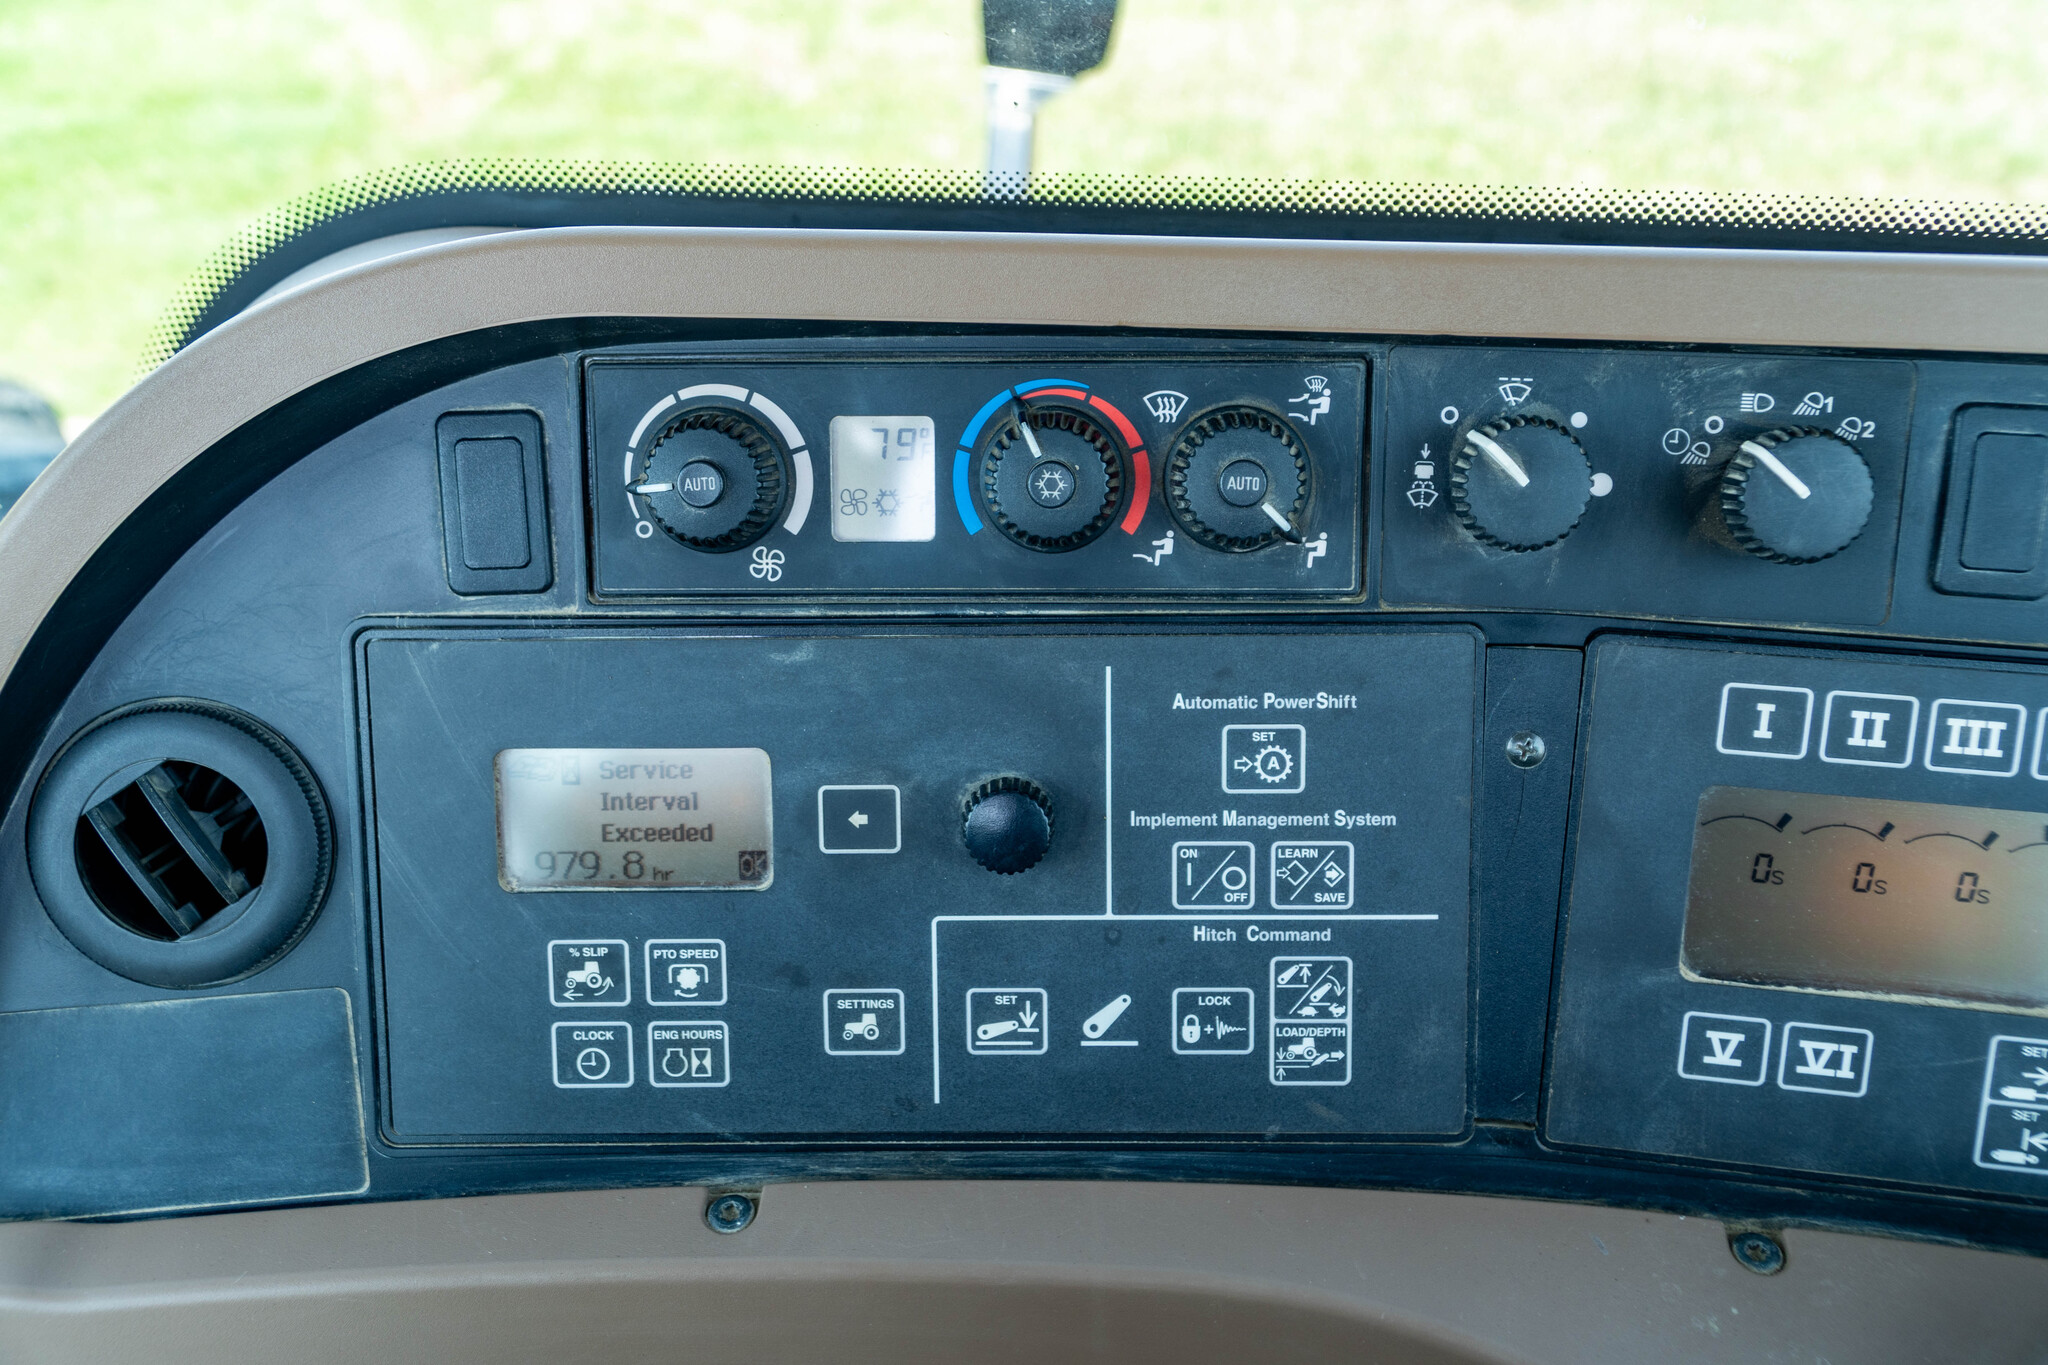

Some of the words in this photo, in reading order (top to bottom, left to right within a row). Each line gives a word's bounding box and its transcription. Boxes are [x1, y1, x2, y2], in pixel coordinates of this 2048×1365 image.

[1824, 396, 1834, 413] 1
[1861, 421, 1876, 439] 2
[683, 476, 716, 492] AUTO
[1226, 476, 1260, 491] AUTO
[1172, 693, 1258, 710] Automatic
[1263, 692, 1358, 710] PowerShift
[1753, 702, 1776, 739] I
[1252, 732, 1276, 742] SET
[1847, 710, 1891, 748] II
[1943, 718, 2007, 758] III
[599, 760, 693, 780] Service
[600, 792, 699, 811] Interval
[1130, 810, 1218, 830] Implement
[1222, 809, 1330, 830] Management
[1334, 809, 1397, 829] System
[601, 823, 714, 843] Exceeded
[1180, 849, 1198, 859] ON
[1278, 849, 1319, 859] LEARN
[534, 851, 645, 880] 979.8
[653, 867, 675, 881] hr
[739, 851, 767, 880] OK
[1224, 893, 1248, 903] OFF
[1314, 893, 1346, 903] SAVE
[1193, 925, 1237, 942] Hitch
[1246, 925, 1331, 942] Command
[569, 947, 580, 957] %
[582, 947, 609, 958] SLIP
[653, 949, 677, 960] PTO
[679, 949, 719, 960] SPEED
[837, 999, 895, 1010] SETTINGS
[994, 995, 1018, 1006] SET
[1198, 995, 1231, 1006] LOCK
[573, 1030, 615, 1041] CLOCK
[653, 1030, 679, 1040] ENG
[681, 1029, 723, 1040] HOURS
[1276, 1027, 1346, 1038] LOAD/DEPTH
[1703, 1030, 1746, 1067] V
[1796, 1039, 1858, 1080] VI
[2011, 1109, 2040, 1122] SET
